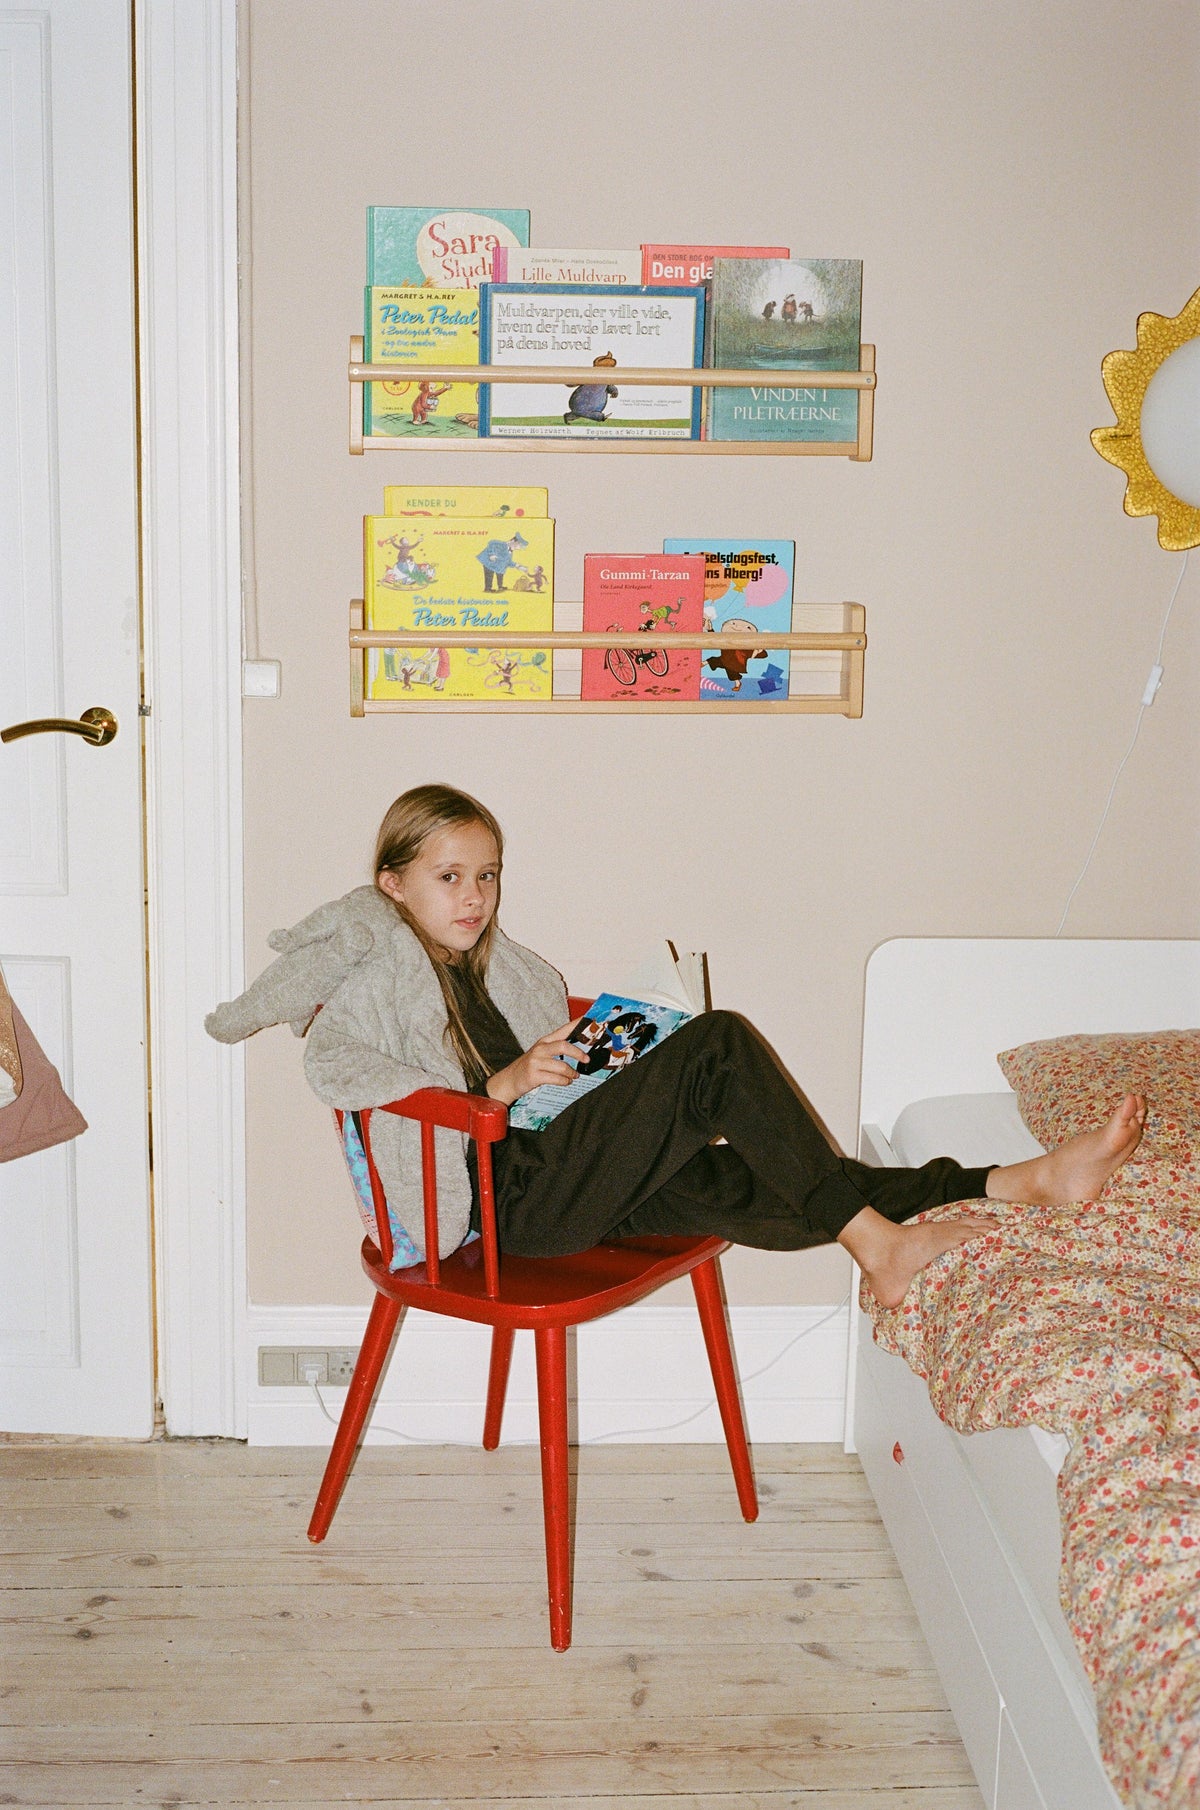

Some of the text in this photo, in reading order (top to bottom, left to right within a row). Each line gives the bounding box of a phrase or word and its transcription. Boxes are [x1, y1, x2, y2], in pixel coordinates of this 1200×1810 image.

[428, 221, 500, 258] Sara
[522, 267, 627, 285] Lille Muldvarp
[652, 261, 685, 279] Den
[379, 303, 478, 325] Peter Pedal
[584, 304, 606, 318] der
[609, 305, 638, 319] ville
[642, 305, 672, 320] vide,
[387, 325, 430, 337] Zoologisk
[497, 319, 660, 336] hvem der havde lavet lort
[497, 335, 591, 354] på dens hoved
[750, 387, 816, 402] VINDEN
[734, 406, 841, 421] PILETRÆERNE
[586, 429, 612, 437] Tegnet
[724, 564, 763, 582] Åberg!
[412, 607, 509, 627] Peter Pedal
